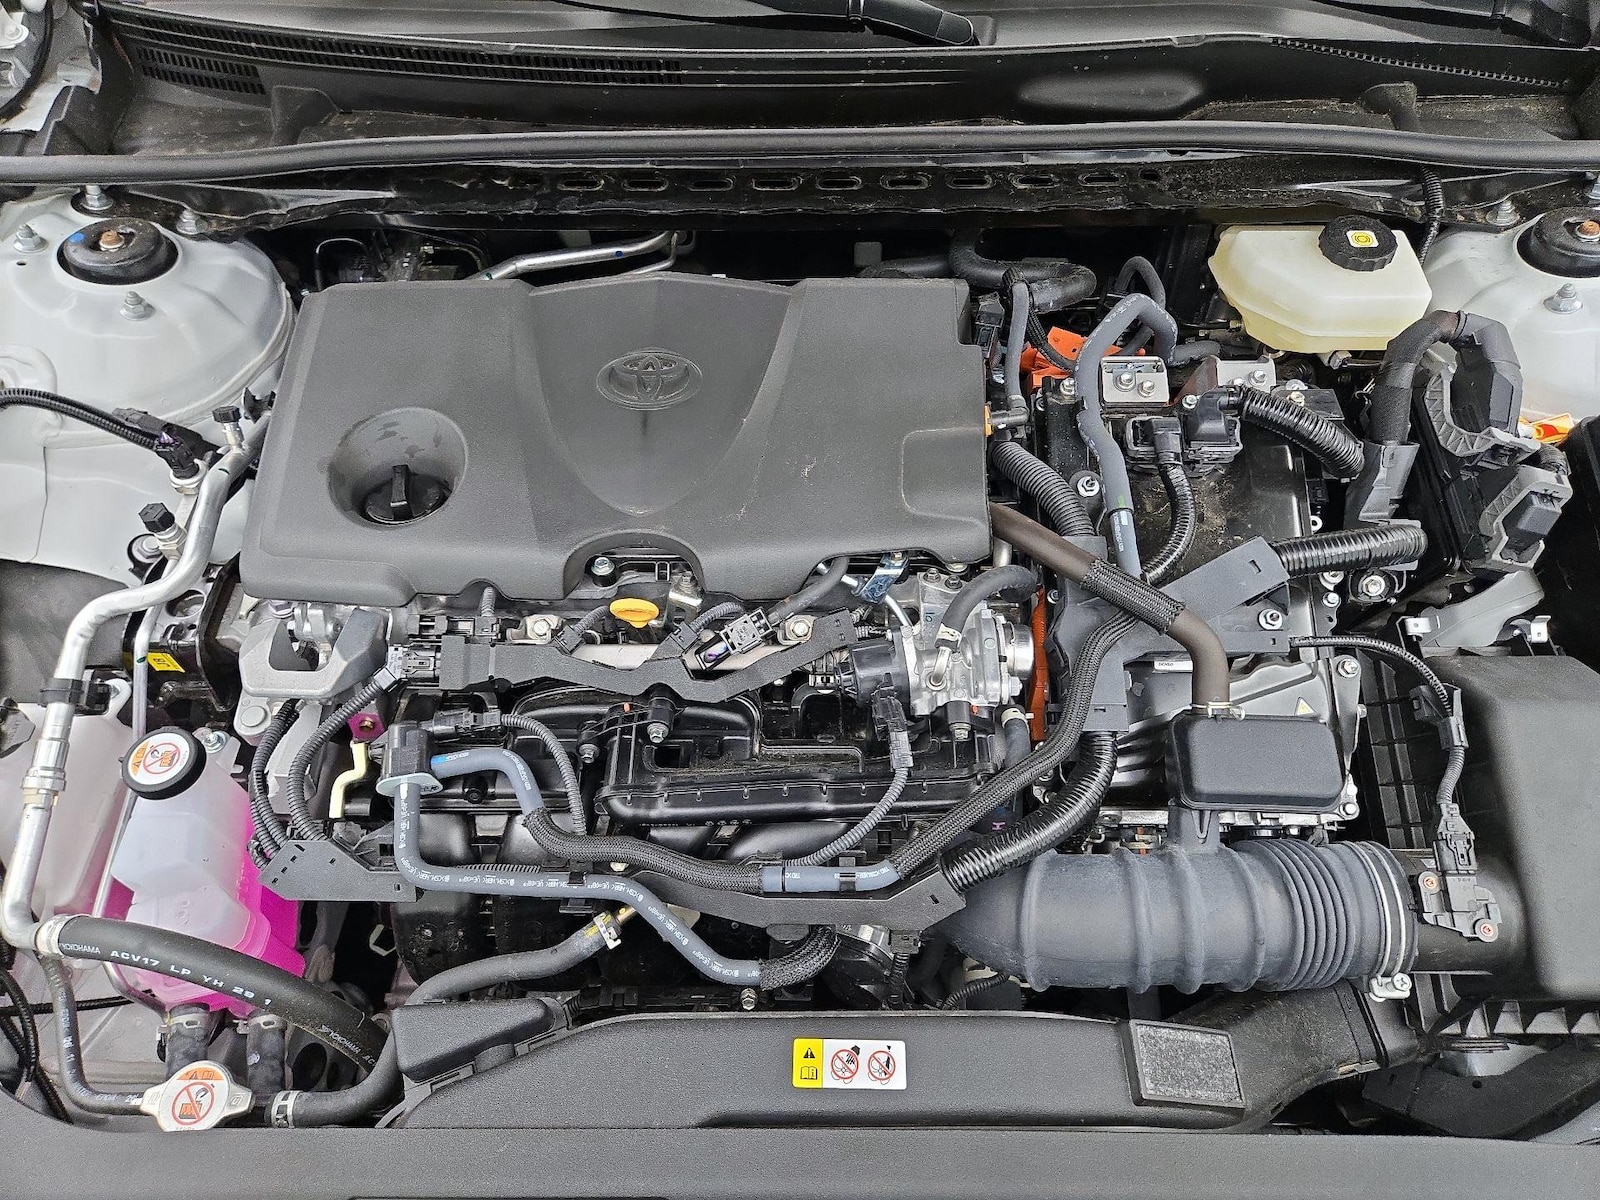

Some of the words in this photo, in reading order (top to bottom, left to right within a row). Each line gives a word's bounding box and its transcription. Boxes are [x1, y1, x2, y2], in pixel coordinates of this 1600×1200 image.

[62, 943, 101, 955] YOKOHAMA
[110, 950, 160, 967] ACV17
[169, 964, 192, 975] LP
[202, 974, 224, 988] YH
